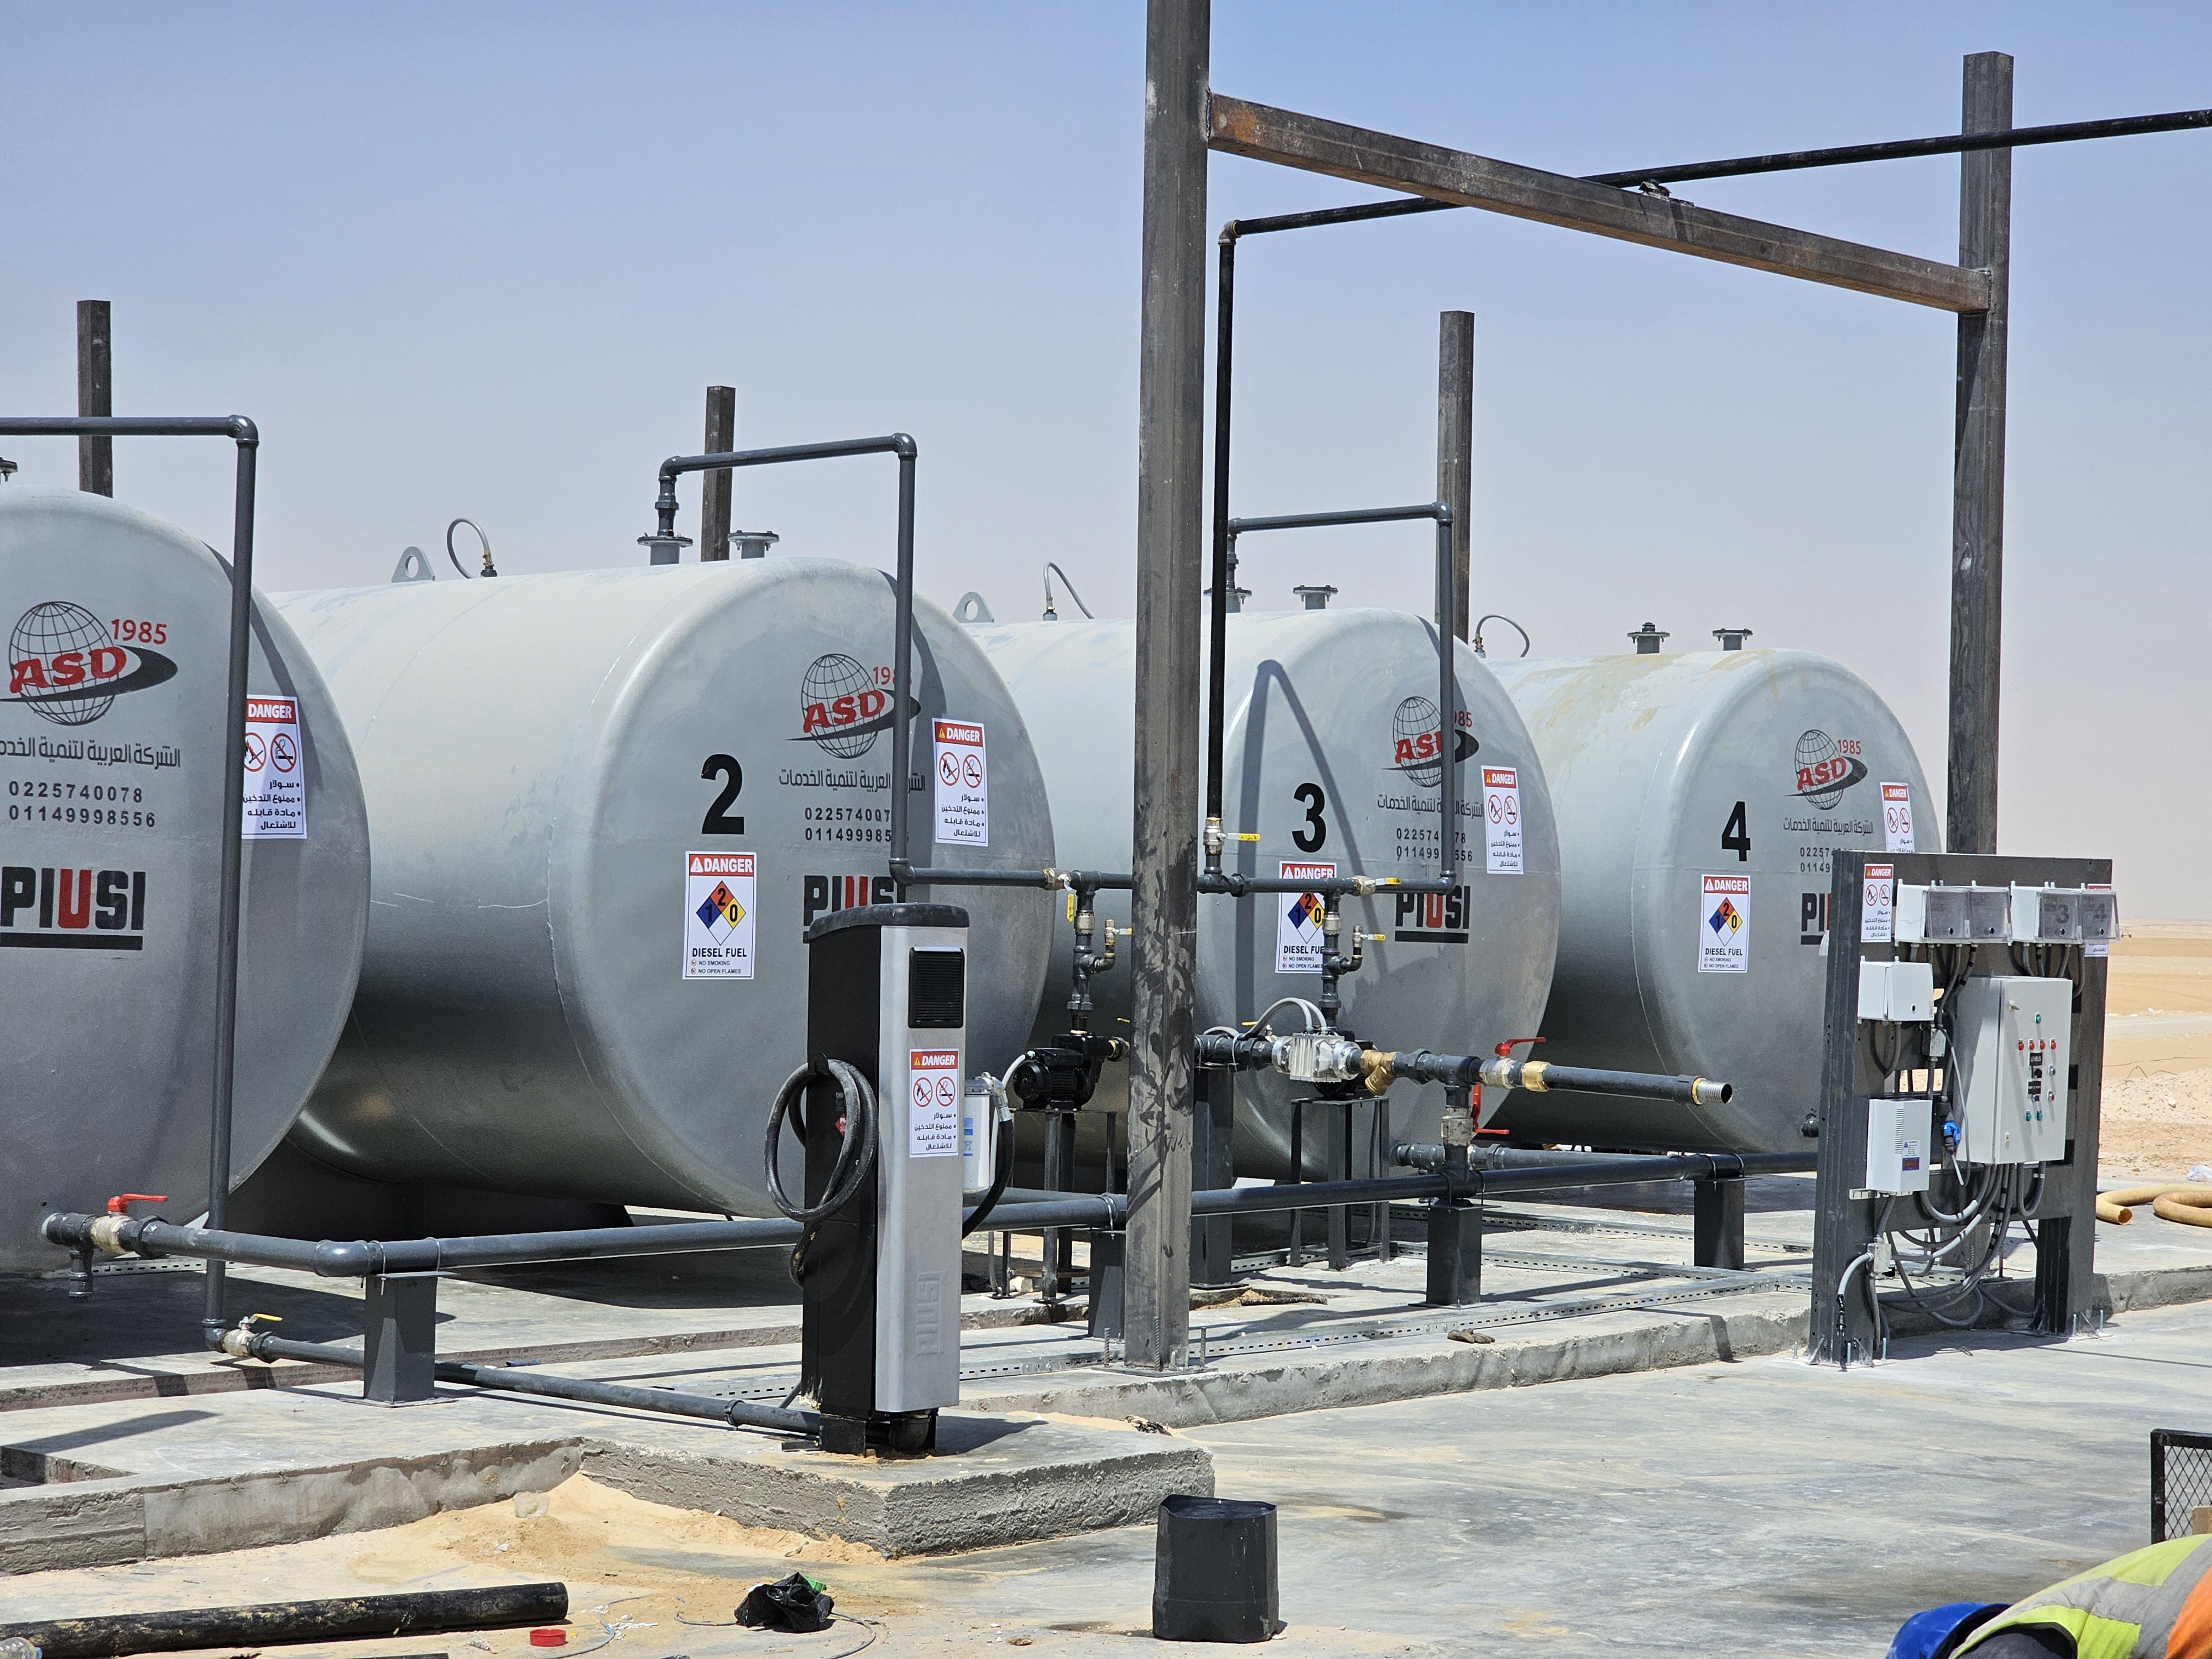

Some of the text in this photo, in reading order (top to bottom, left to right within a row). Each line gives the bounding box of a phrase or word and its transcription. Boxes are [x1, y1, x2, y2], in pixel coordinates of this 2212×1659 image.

[111, 619, 167, 644] 1985
[9, 646, 127, 693] ASD
[873, 666, 912, 685] 19
[248, 704, 291, 718] DANGER
[803, 690, 885, 733] ASD
[1454, 710, 1472, 728] 85
[947, 727, 980, 742] DANGER
[39, 736, 84, 763] لتنمية
[87, 739, 132, 766] العربية
[1838, 739, 1861, 755] 1985
[133, 743, 181, 770] الشركة
[779, 769, 926, 794] الشر العربية لتنمية الخدمات
[1492, 773, 1514, 785] DANGER
[1797, 757, 1846, 791] ASD
[9, 781, 143, 803] 0225740078
[269, 780, 294, 790] سولار
[272, 795, 295, 804] ممنوع
[701, 754, 745, 834] 2
[961, 794, 980, 802] سولار
[1889, 789, 1907, 798] DANGER
[942, 805, 980, 815] ممنوع التدخين
[1378, 794, 1410, 811] الخدمات
[1412, 795, 1435, 815] لتنمية
[1460, 800, 1484, 820] الشركة
[9, 805, 155, 827] 01149998556
[275, 808, 295, 817] مادة
[805, 807, 890, 822] 022574007
[1292, 782, 1326, 853] 3
[260, 821, 296, 831] للاشتعال
[964, 819, 980, 827] مادة
[1783, 818, 1811, 831] الخدمات
[1854, 820, 1874, 836] الشركة
[805, 827, 909, 842] 011499985
[953, 829, 980, 838] للاشتعال
[1396, 828, 1465, 843] 02257478
[1721, 801, 1751, 862] 4
[1396, 846, 1473, 862] 011499556
[704, 858, 753, 873] DANGER
[1294, 867, 1333, 879] DANGER
[1871, 868, 1891, 877] DANGER
[1714, 880, 1747, 891] DANGER
[0, 866, 146, 931] PIUSI
[717, 888, 726, 906] 2
[1305, 893, 1312, 909] 2
[706, 904, 712, 922] 1
[729, 904, 738, 922] 0
[1296, 907, 1301, 923] 1
[1395, 885, 1470, 929] PIUSI
[1723, 902, 1729, 916] 2
[2055, 904, 2069, 924] 3
[1314, 907, 1322, 924] 0
[1716, 915, 1720, 928] 1
[1731, 915, 1737, 928] 0
[692, 948, 747, 957] DIESEL FUEL
[1284, 946, 1324, 954] DIESEL FUE
[922, 1055, 955, 1066] DANGER
[926, 1142, 952, 1151] للاشتعال
